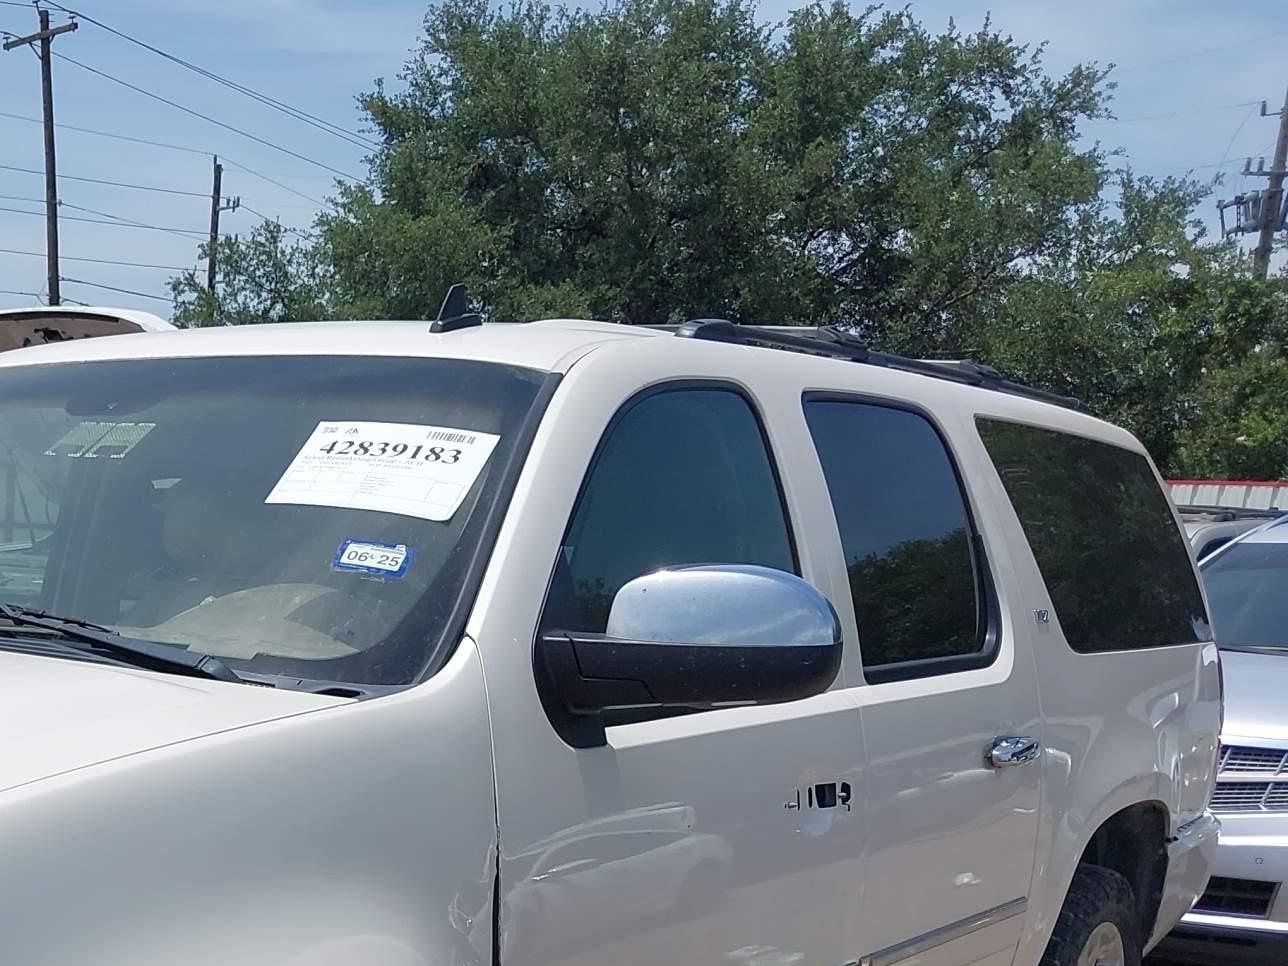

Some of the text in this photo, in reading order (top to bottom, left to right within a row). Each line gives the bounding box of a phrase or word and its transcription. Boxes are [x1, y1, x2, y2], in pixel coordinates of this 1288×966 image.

[319, 440, 462, 465] 42839183
[347, 550, 370, 562] 06
[377, 555, 401, 567] 25
